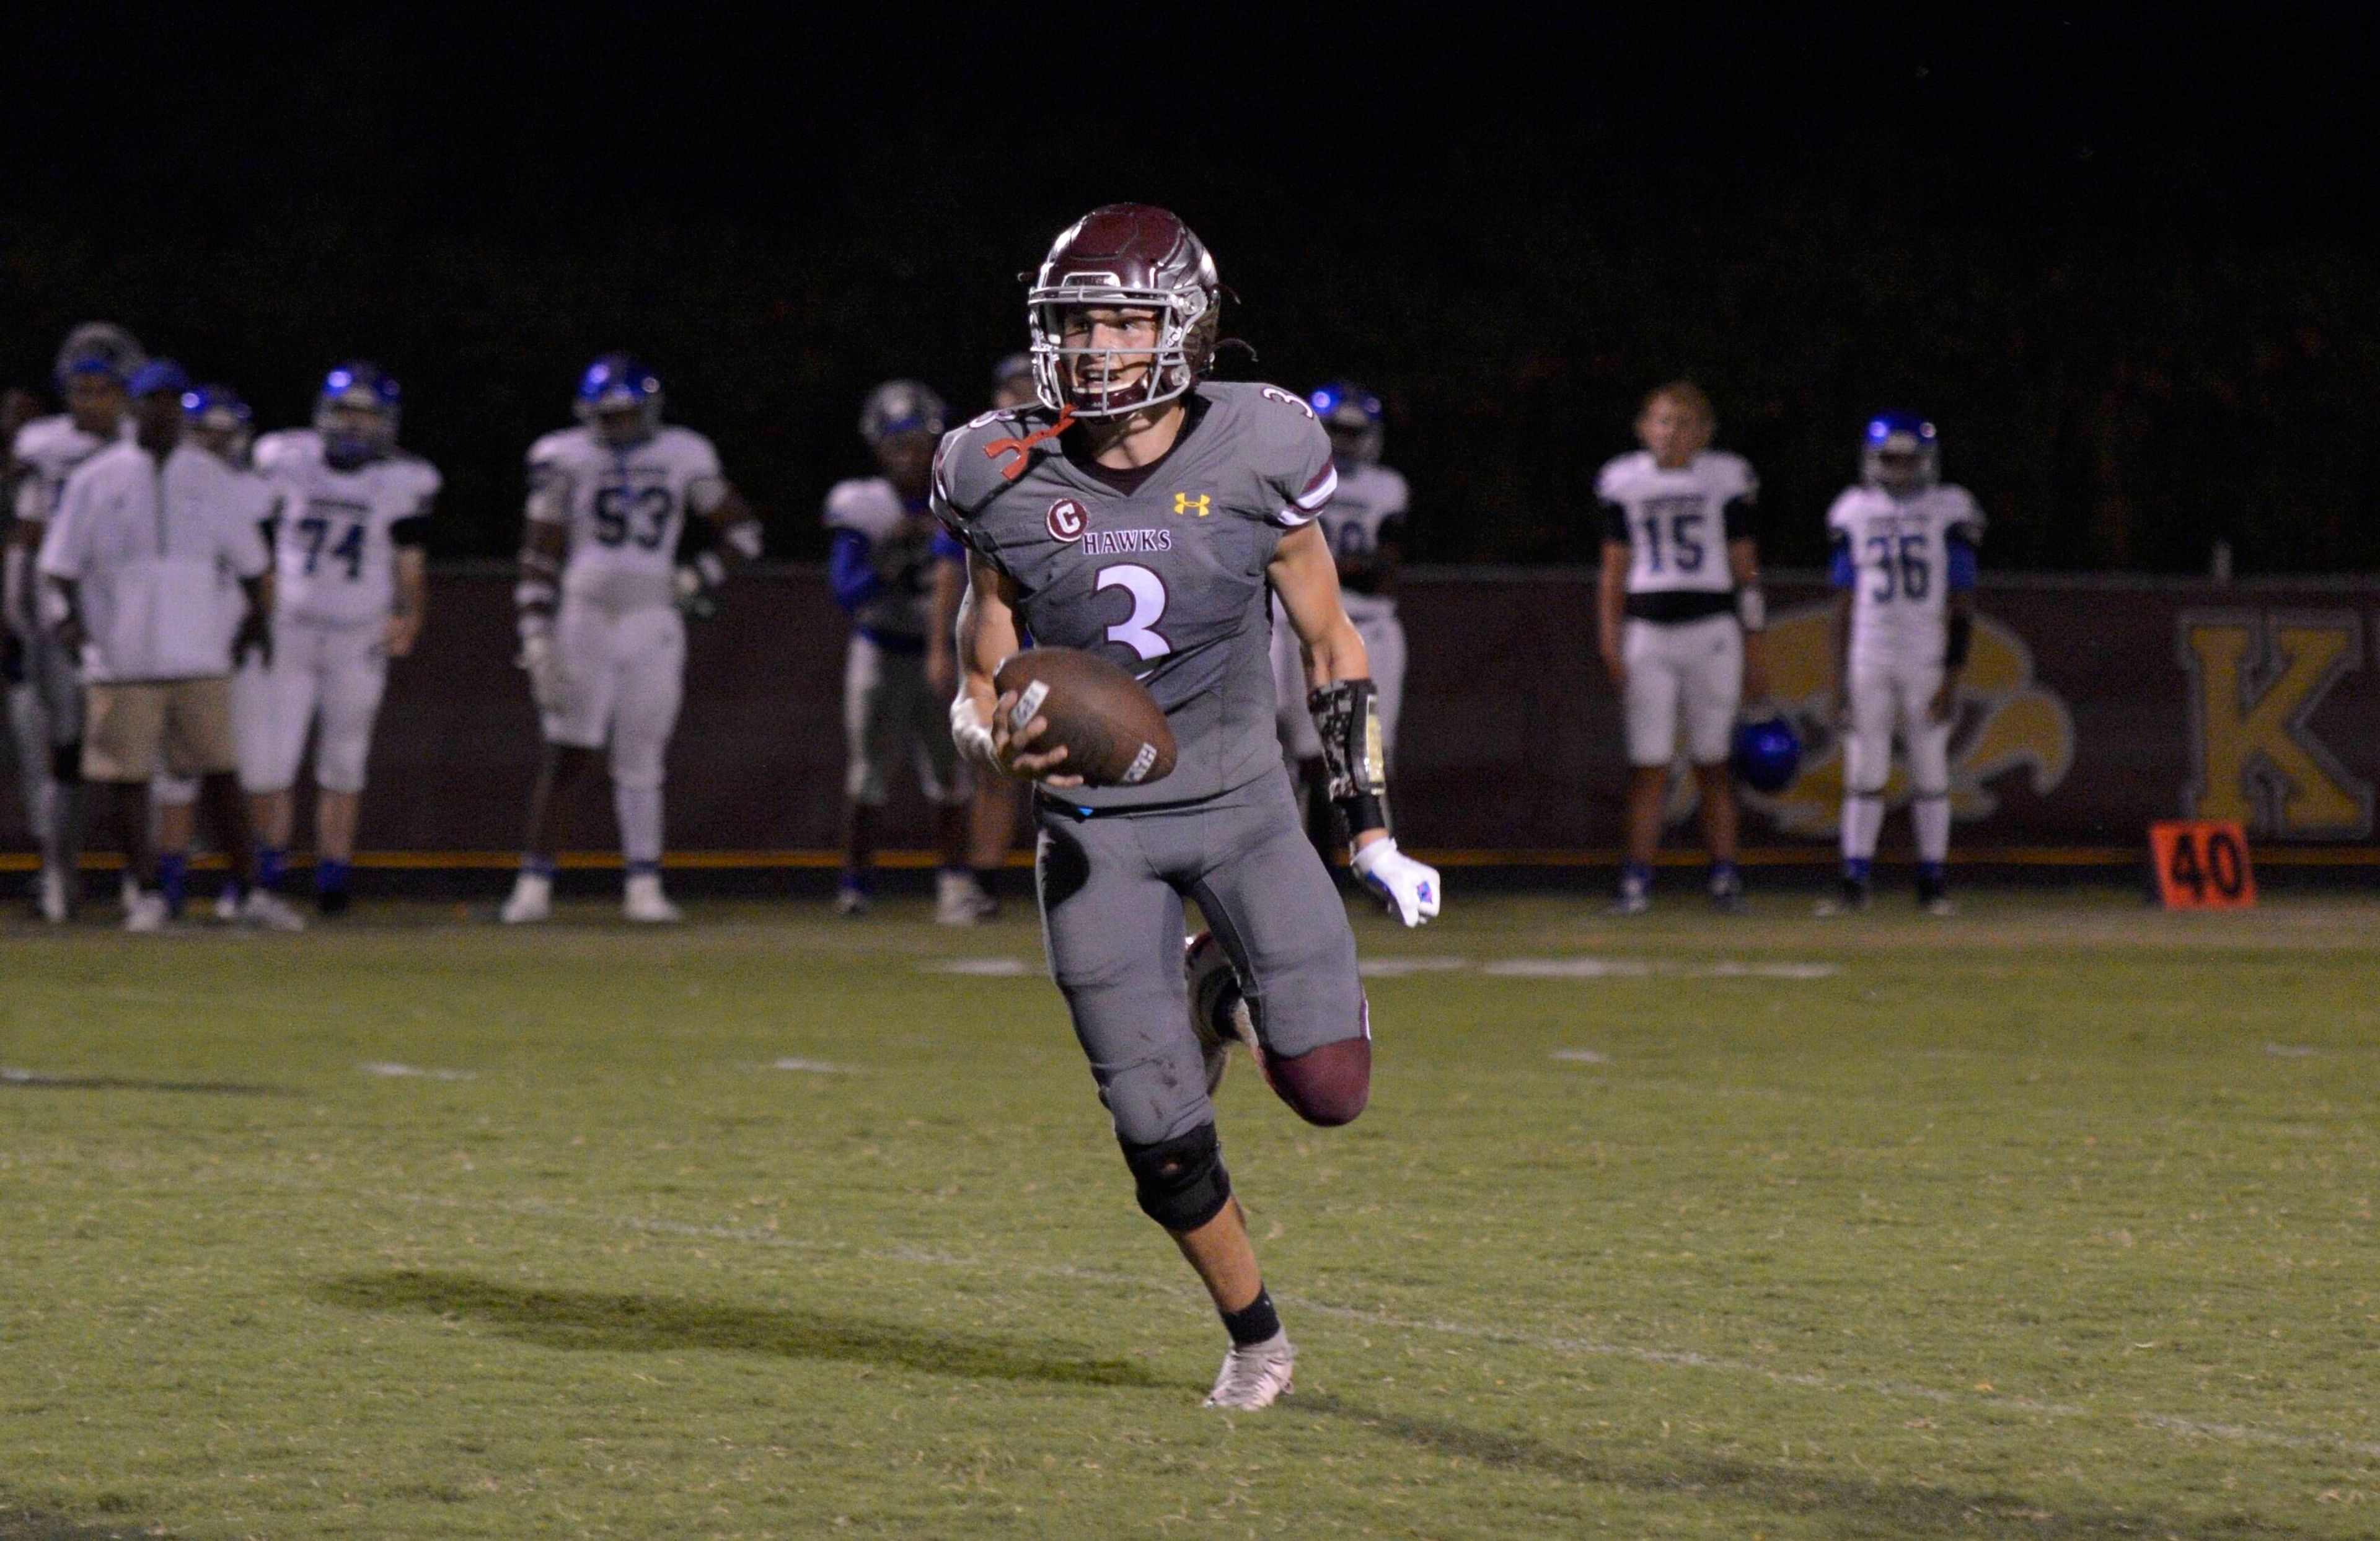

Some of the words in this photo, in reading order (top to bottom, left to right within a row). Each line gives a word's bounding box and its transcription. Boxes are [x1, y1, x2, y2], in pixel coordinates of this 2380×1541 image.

[1261, 387, 1313, 419] 3
[594, 486, 672, 549] 53
[1056, 503, 1080, 533] C
[1083, 529, 1171, 555] HAWKS
[1644, 514, 1704, 574] 15
[299, 518, 363, 579] 74
[1866, 536, 1929, 602] 36
[1091, 562, 1174, 680] 3
[2174, 834, 2242, 899] 40
